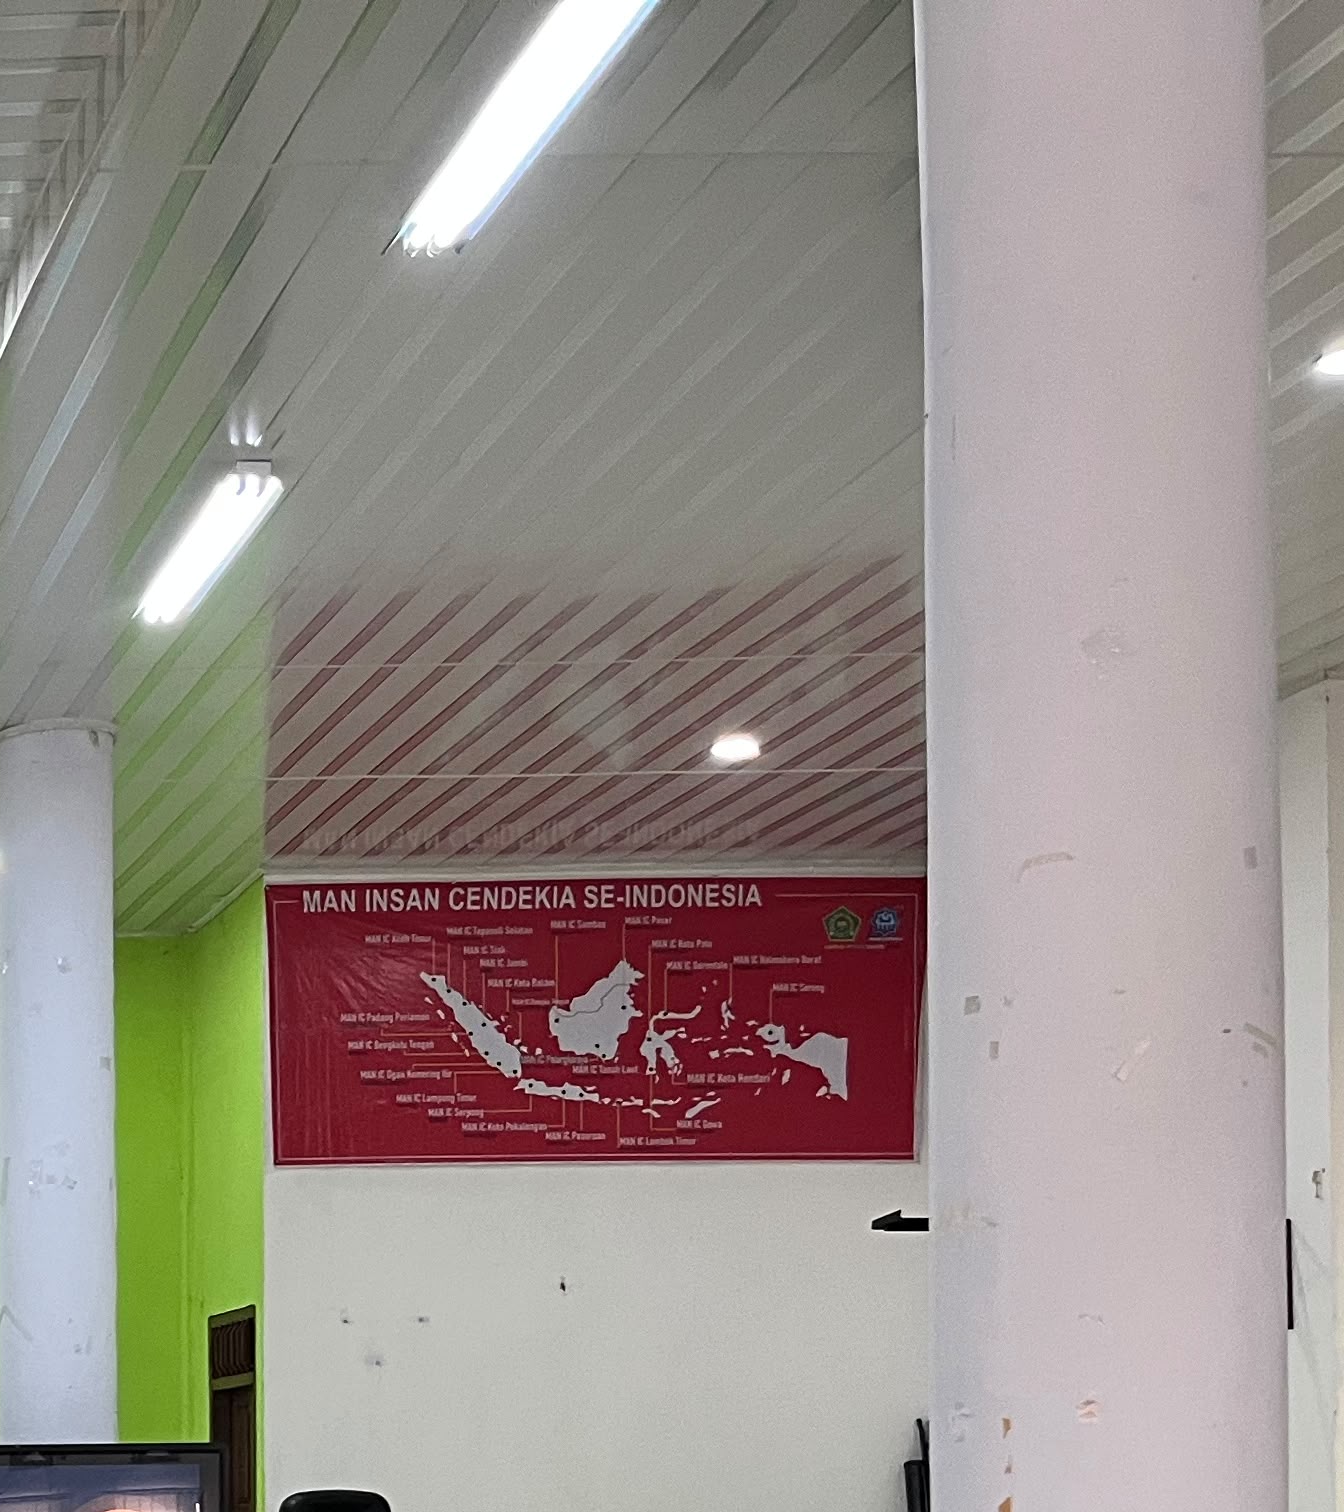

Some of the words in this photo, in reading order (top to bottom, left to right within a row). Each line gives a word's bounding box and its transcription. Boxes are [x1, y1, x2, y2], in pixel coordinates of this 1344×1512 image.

[302, 888, 356, 913] MAN
[365, 887, 440, 913] INSAN
[448, 885, 576, 911] CENDEKIA
[583, 883, 763, 909] SE-INDONESIA
